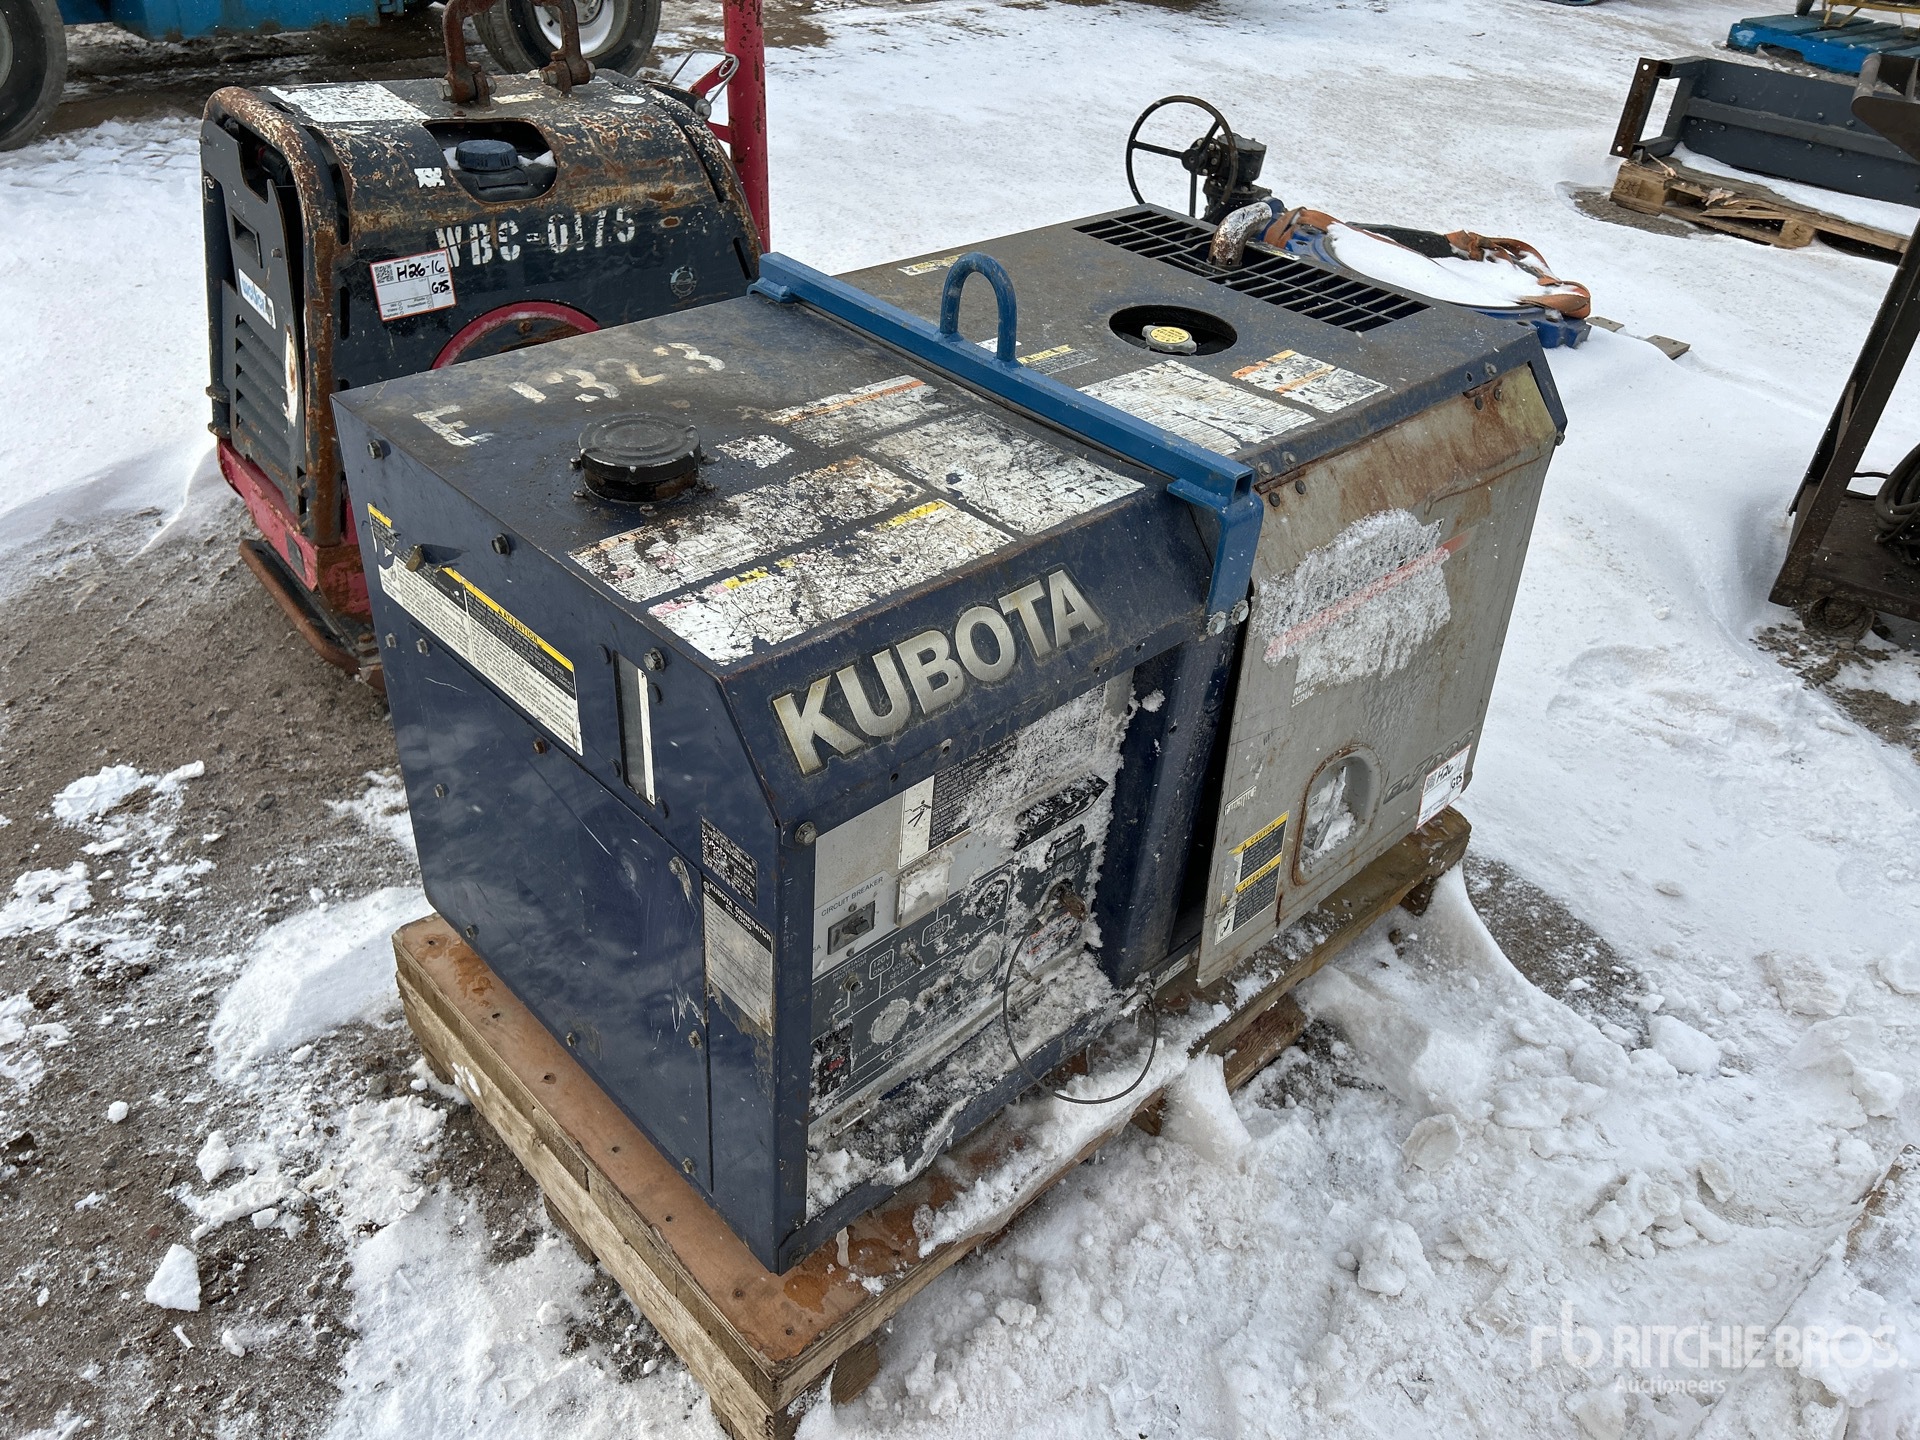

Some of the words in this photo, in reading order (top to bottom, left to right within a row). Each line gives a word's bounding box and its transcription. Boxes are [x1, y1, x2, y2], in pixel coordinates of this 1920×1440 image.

[434, 207, 636, 268] WBC-0175
[396, 260, 446, 282] H26-16
[772, 569, 1104, 775] KUBOTA
[1250, 824, 1276, 844] CAUTION
[1242, 864, 1272, 888] ATTENTION
[821, 896, 849, 917] CIRCUIT
[851, 876, 883, 900] BREAKER
[709, 882, 734, 909] KUBOTA
[734, 906, 772, 943] GENERATOR
[832, 953, 868, 978] RECEPTACLE
[872, 953, 891, 968] 120V
[872, 961, 891, 977] ONLY
